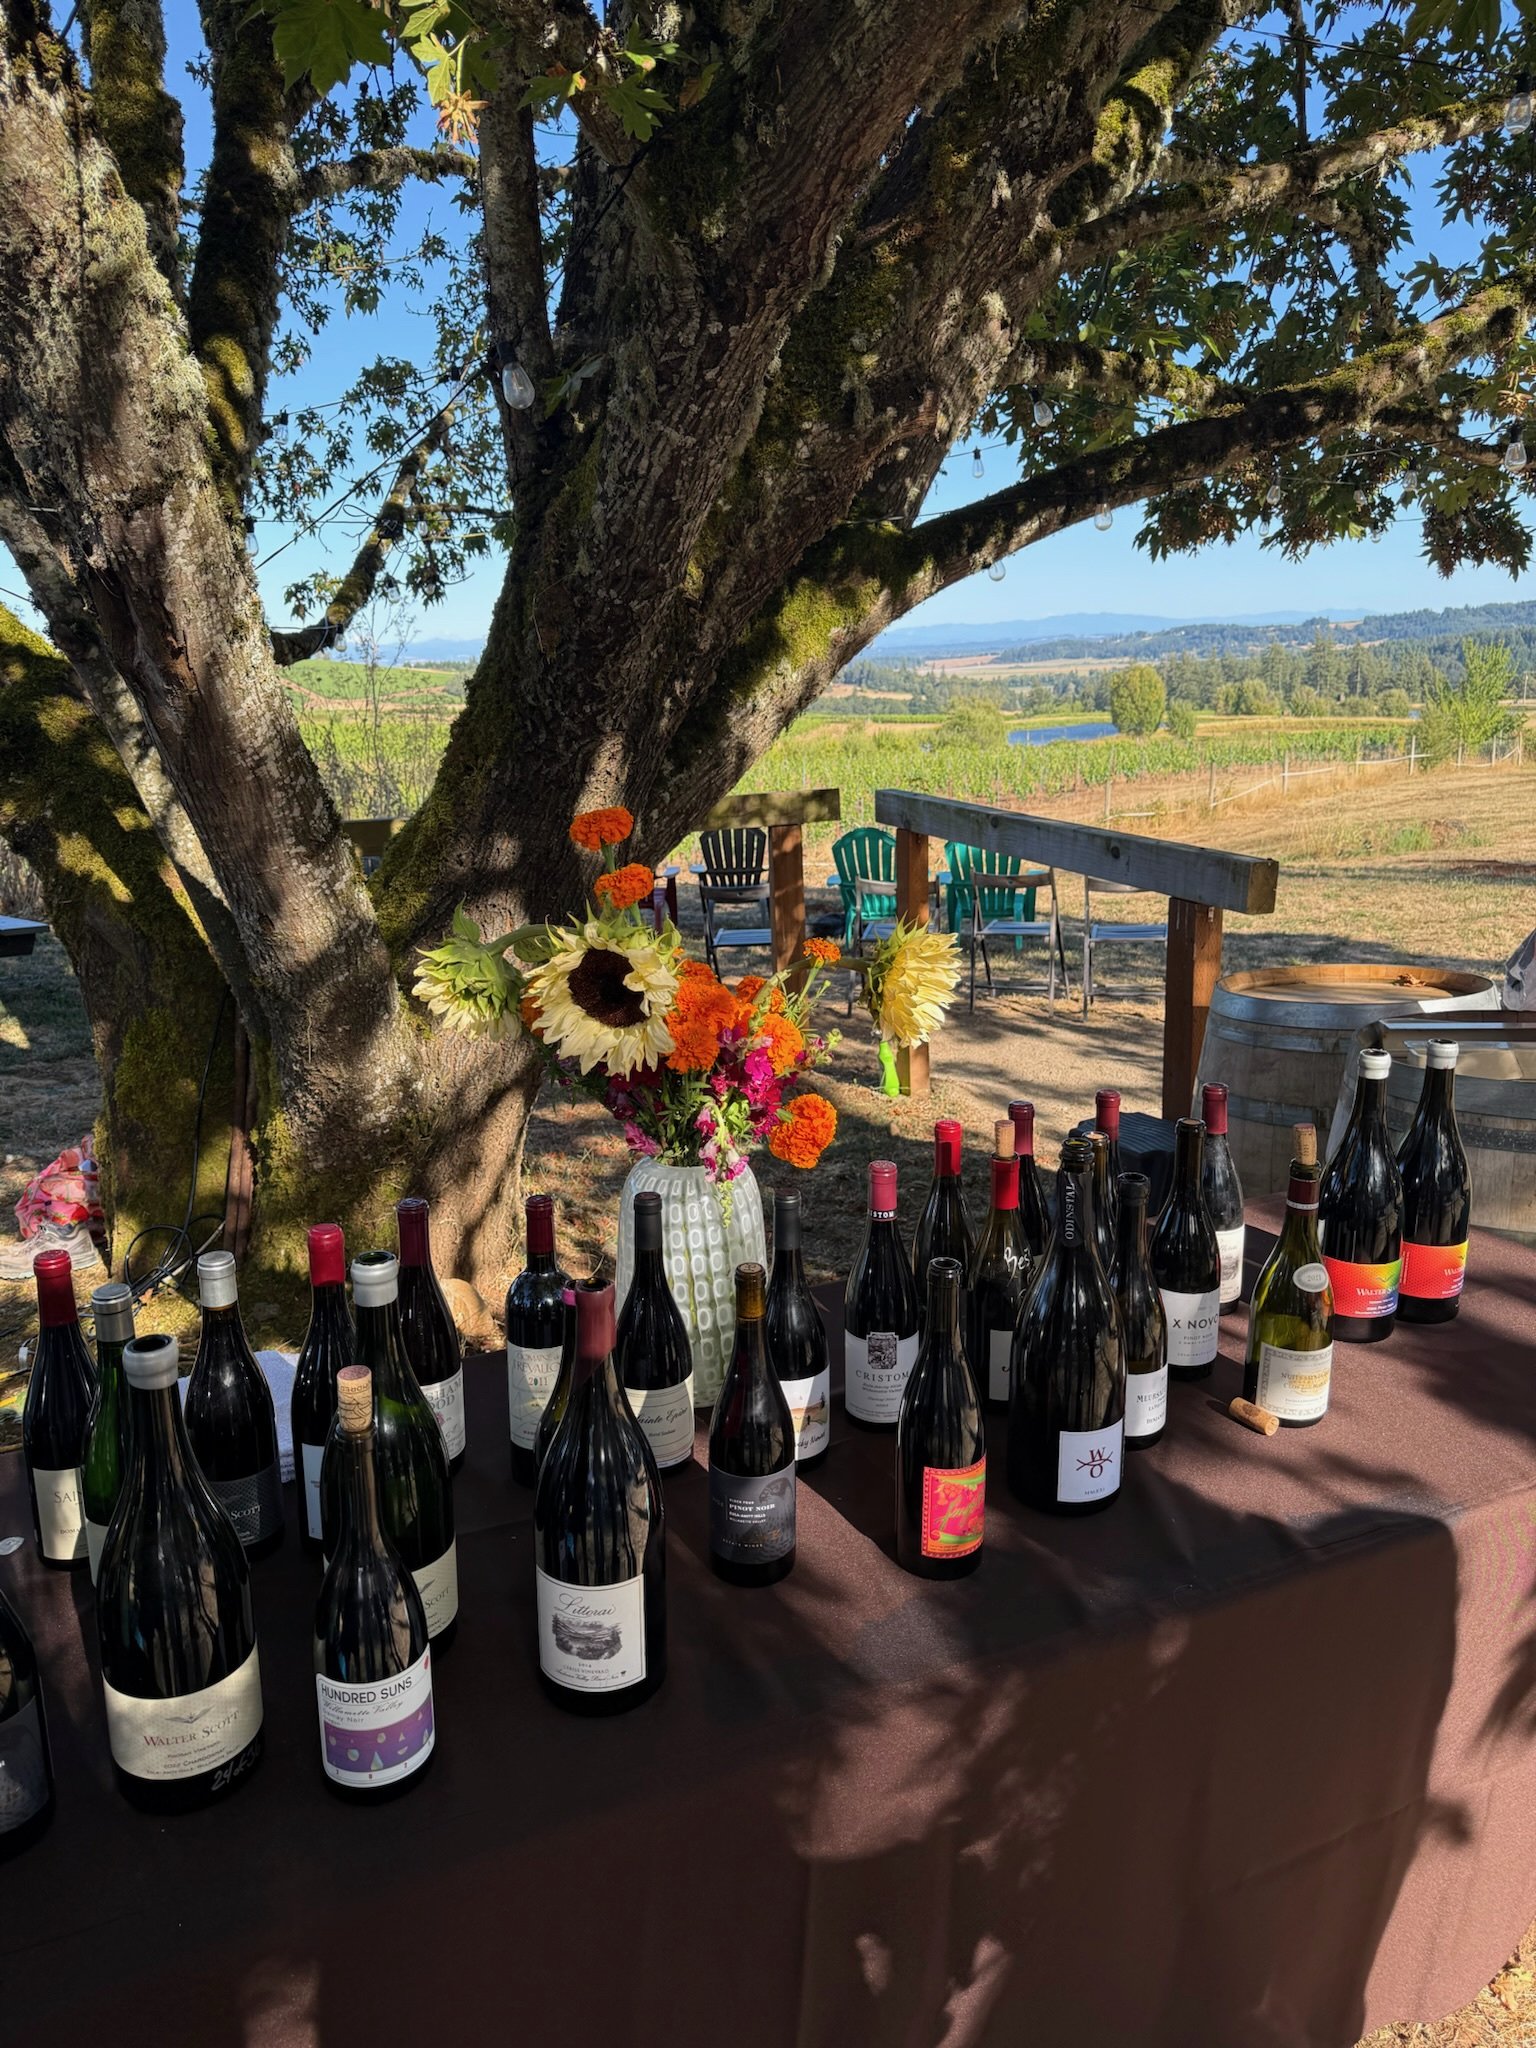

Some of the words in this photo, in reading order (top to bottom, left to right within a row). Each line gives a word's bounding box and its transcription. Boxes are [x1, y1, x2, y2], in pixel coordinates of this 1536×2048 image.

[1065, 1183, 1076, 1240] ODINSTAL
[1355, 1287, 1386, 1296] WALTER
[1172, 1318, 1182, 1329] X
[855, 1369, 910, 1383] CRISTOM
[1090, 1446, 1107, 1463] W
[728, 1503, 754, 1512] PINOT
[755, 1503, 776, 1512] NOIR
[553, 1593, 617, 1619] Littorai
[320, 1683, 377, 1704] HUNDRED
[380, 1676, 413, 1700] SUNS
[323, 1700, 371, 1717] Willamette
[371, 1700, 404, 1715] Valley
[143, 1735, 197, 1748] WALTER
[201, 1708, 240, 1740] SCOTT
[182, 1747, 226, 1767] CHARDONNAY
